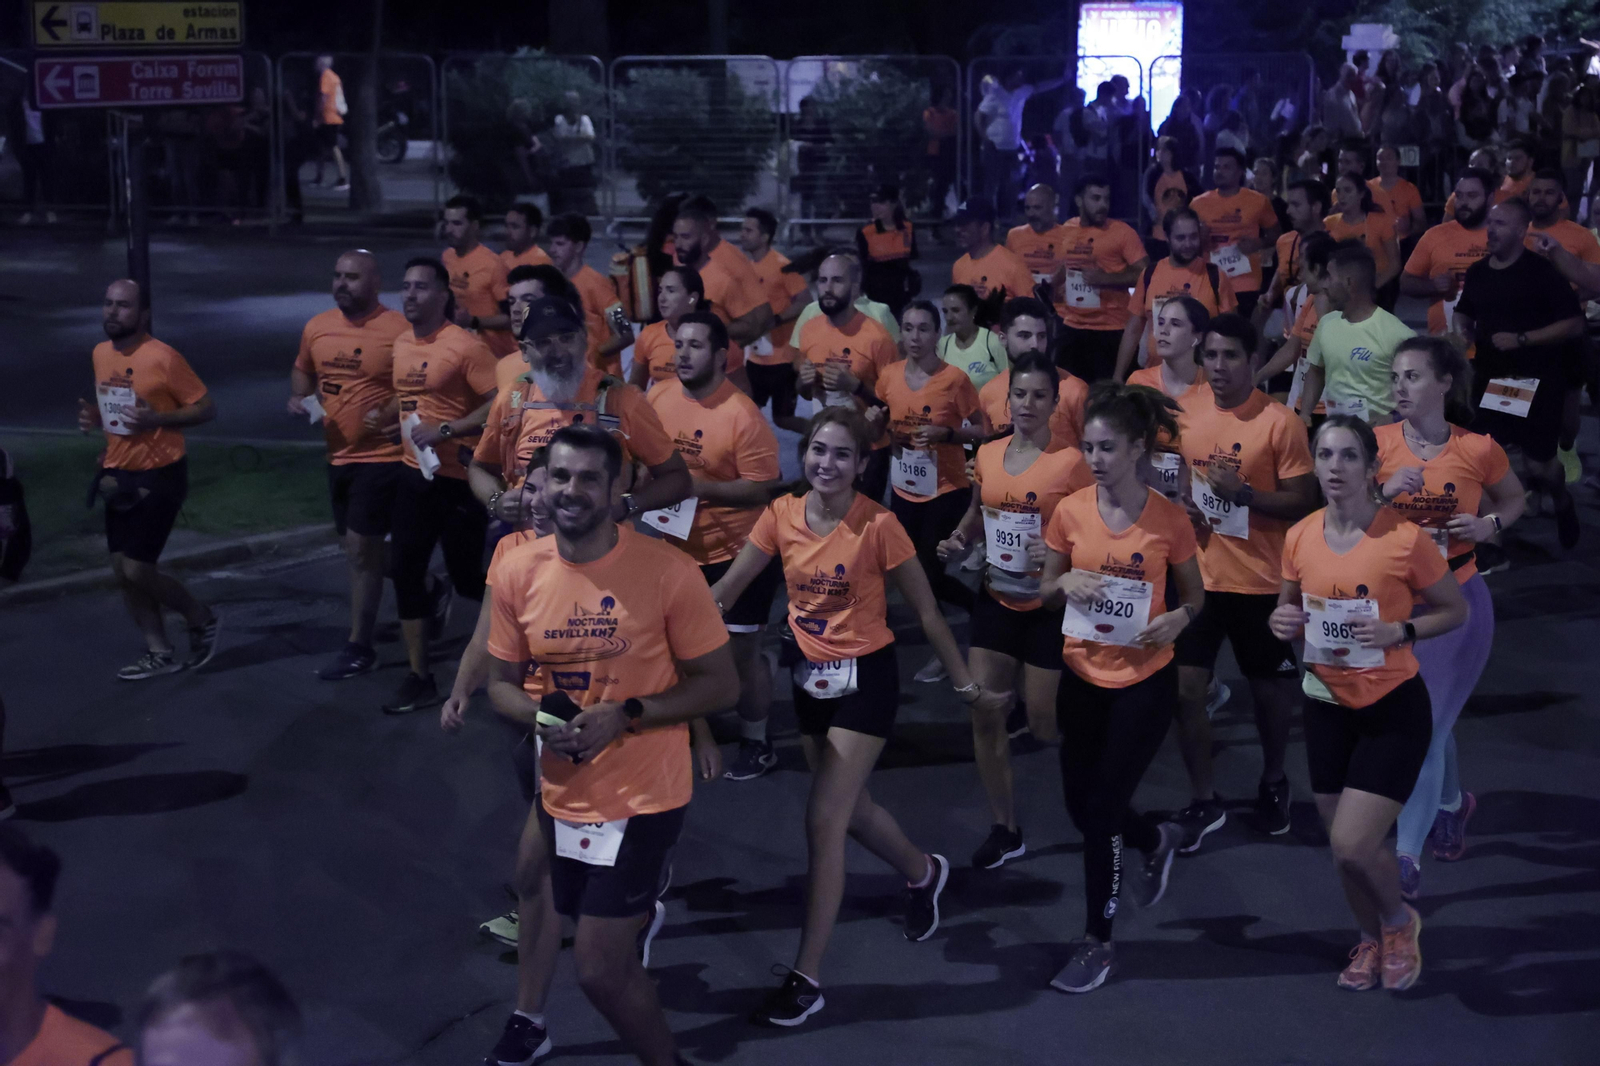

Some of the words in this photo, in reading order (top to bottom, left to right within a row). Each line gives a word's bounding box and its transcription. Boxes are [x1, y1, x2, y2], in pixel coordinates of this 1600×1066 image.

[101, 23, 145, 40] Plaza
[156, 24, 175, 40] de
[186, 22, 236, 39] Armas
[131, 61, 178, 79] Caixa
[187, 59, 238, 78] Forum
[128, 82, 173, 99] Torre
[182, 80, 237, 98] Sevilla
[898, 461, 927, 477] 13186
[1202, 493, 1231, 513] 9870
[1392, 502, 1432, 510] SEVILLA
[1412, 497, 1458, 505] NOCTURNA
[995, 529, 1021, 547] 9931
[810, 578, 850, 588] NOCTURNA
[567, 618, 618, 627] NOCTURNA
[544, 629, 589, 639] SEVILLA
[1111, 834, 1121, 871] FITNESS
[1112, 873, 1120, 894] NEW
